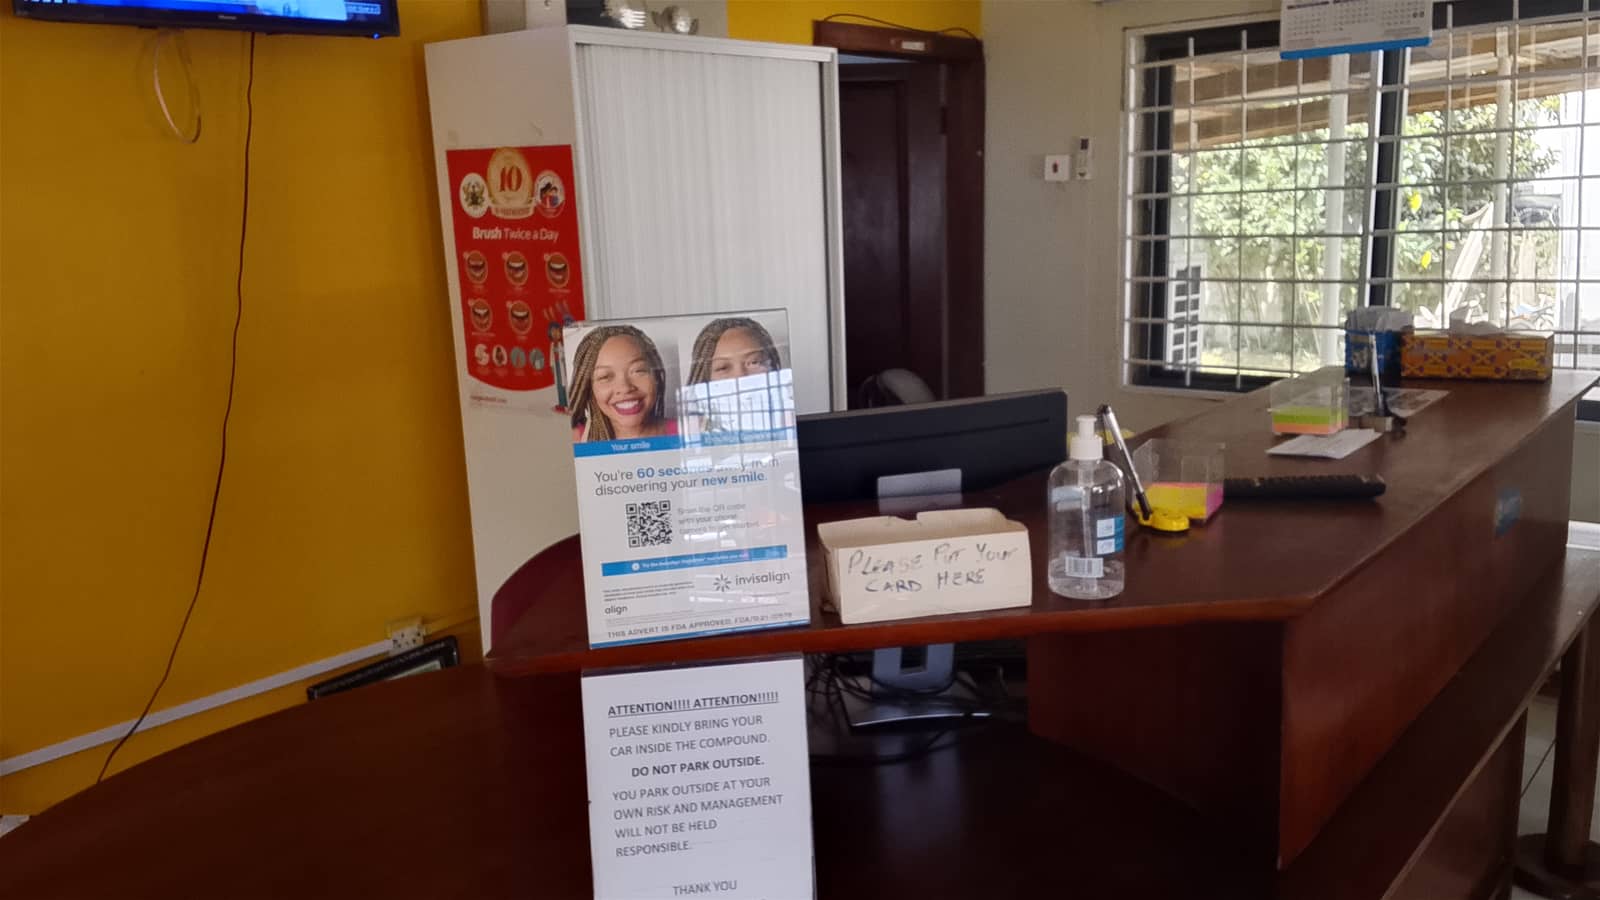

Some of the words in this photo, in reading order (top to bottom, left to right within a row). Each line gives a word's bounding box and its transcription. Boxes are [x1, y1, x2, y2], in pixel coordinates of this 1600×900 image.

[472, 226, 502, 240] Brush
[503, 227, 531, 240] Twice
[532, 230, 539, 240] a
[540, 228, 559, 243] Day
[611, 442, 630, 451] Your
[630, 441, 650, 450] smile
[594, 470, 633, 483] You're
[637, 467, 654, 479] 60
[595, 480, 668, 497] discovering
[670, 479, 699, 492] your
[702, 475, 728, 486] new
[731, 471, 768, 484] smile.
[848, 550, 923, 575] PLEASE
[735, 571, 791, 587] invisalign
[865, 579, 922, 593] CARD
[937, 568, 985, 590] HERE
[604, 605, 628, 615] align
[607, 631, 626, 639] THIS
[628, 627, 660, 637] ADVERT
[661, 625, 669, 633] IS
[671, 623, 687, 631] FDA
[609, 725, 649, 738] PLEASE
[652, 721, 691, 735] KINDLY
[694, 718, 729, 731] BRING
[732, 715, 763, 728] YOUR
[610, 746, 632, 757] CAR
[636, 742, 672, 755] INSIDE
[675, 739, 696, 751] THE
[699, 733, 770, 749] COMPOUND.
[631, 766, 649, 778] DO
[652, 764, 677, 776] NOT
[680, 760, 710, 773] PARK
[713, 756, 765, 770] OUTSIDE.
[612, 789, 637, 801] YOU
[639, 786, 669, 799] PARK
[671, 781, 720, 796] OUTSIDE
[722, 780, 737, 791] AT
[739, 777, 771, 789] YOUR
[613, 807, 643, 820] OWN
[646, 804, 671, 817] RISK
[673, 801, 698, 814] AND
[701, 794, 784, 812] MANAGEMENT
[615, 826, 642, 839] WILL
[645, 824, 668, 836] NOT
[671, 821, 686, 833] BE
[688, 819, 717, 832] HELD
[673, 884, 711, 896] THANK
[713, 880, 737, 891] YOU
